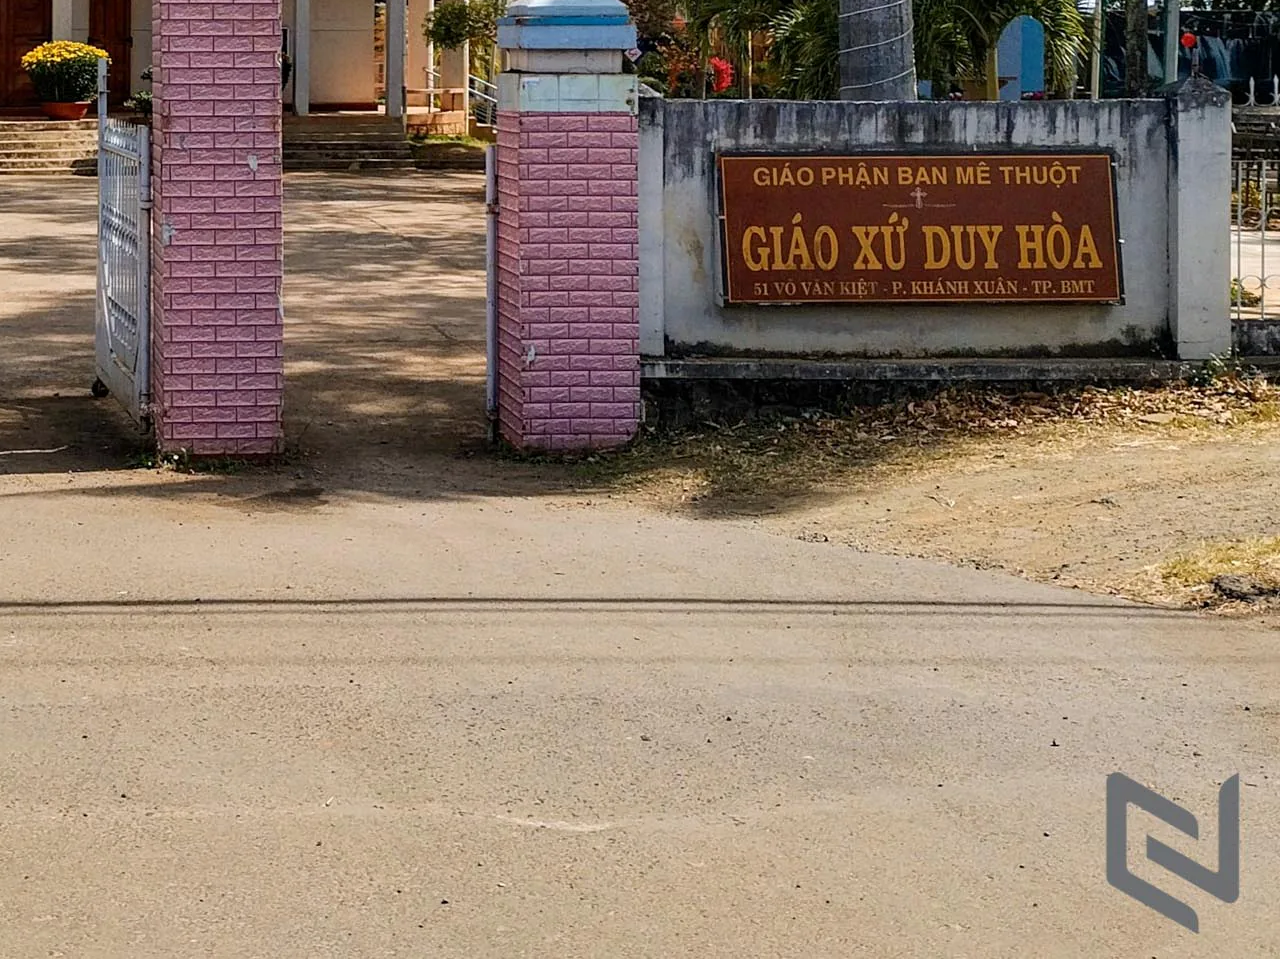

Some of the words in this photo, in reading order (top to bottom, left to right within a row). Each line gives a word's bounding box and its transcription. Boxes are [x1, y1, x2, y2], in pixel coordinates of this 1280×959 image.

[753, 162, 815, 186] GIÁO
[821, 161, 889, 189] PHẬN
[897, 166, 948, 186] BAN
[956, 161, 992, 185] MÊ
[999, 161, 1081, 189] THUỘT
[742, 212, 839, 271] GIÁO
[851, 211, 909, 271] XỨ
[922, 224, 1003, 270] DUY
[1015, 211, 1103, 269] HÒA
[754, 283, 769, 296] 51
[840, 278, 879, 299] KIỆT
[892, 281, 908, 295] P.
[911, 277, 969, 295] KHÁNH
[973, 277, 1018, 295] XUÂN
[1031, 280, 1056, 294] TP.
[1060, 280, 1096, 294] BMT
